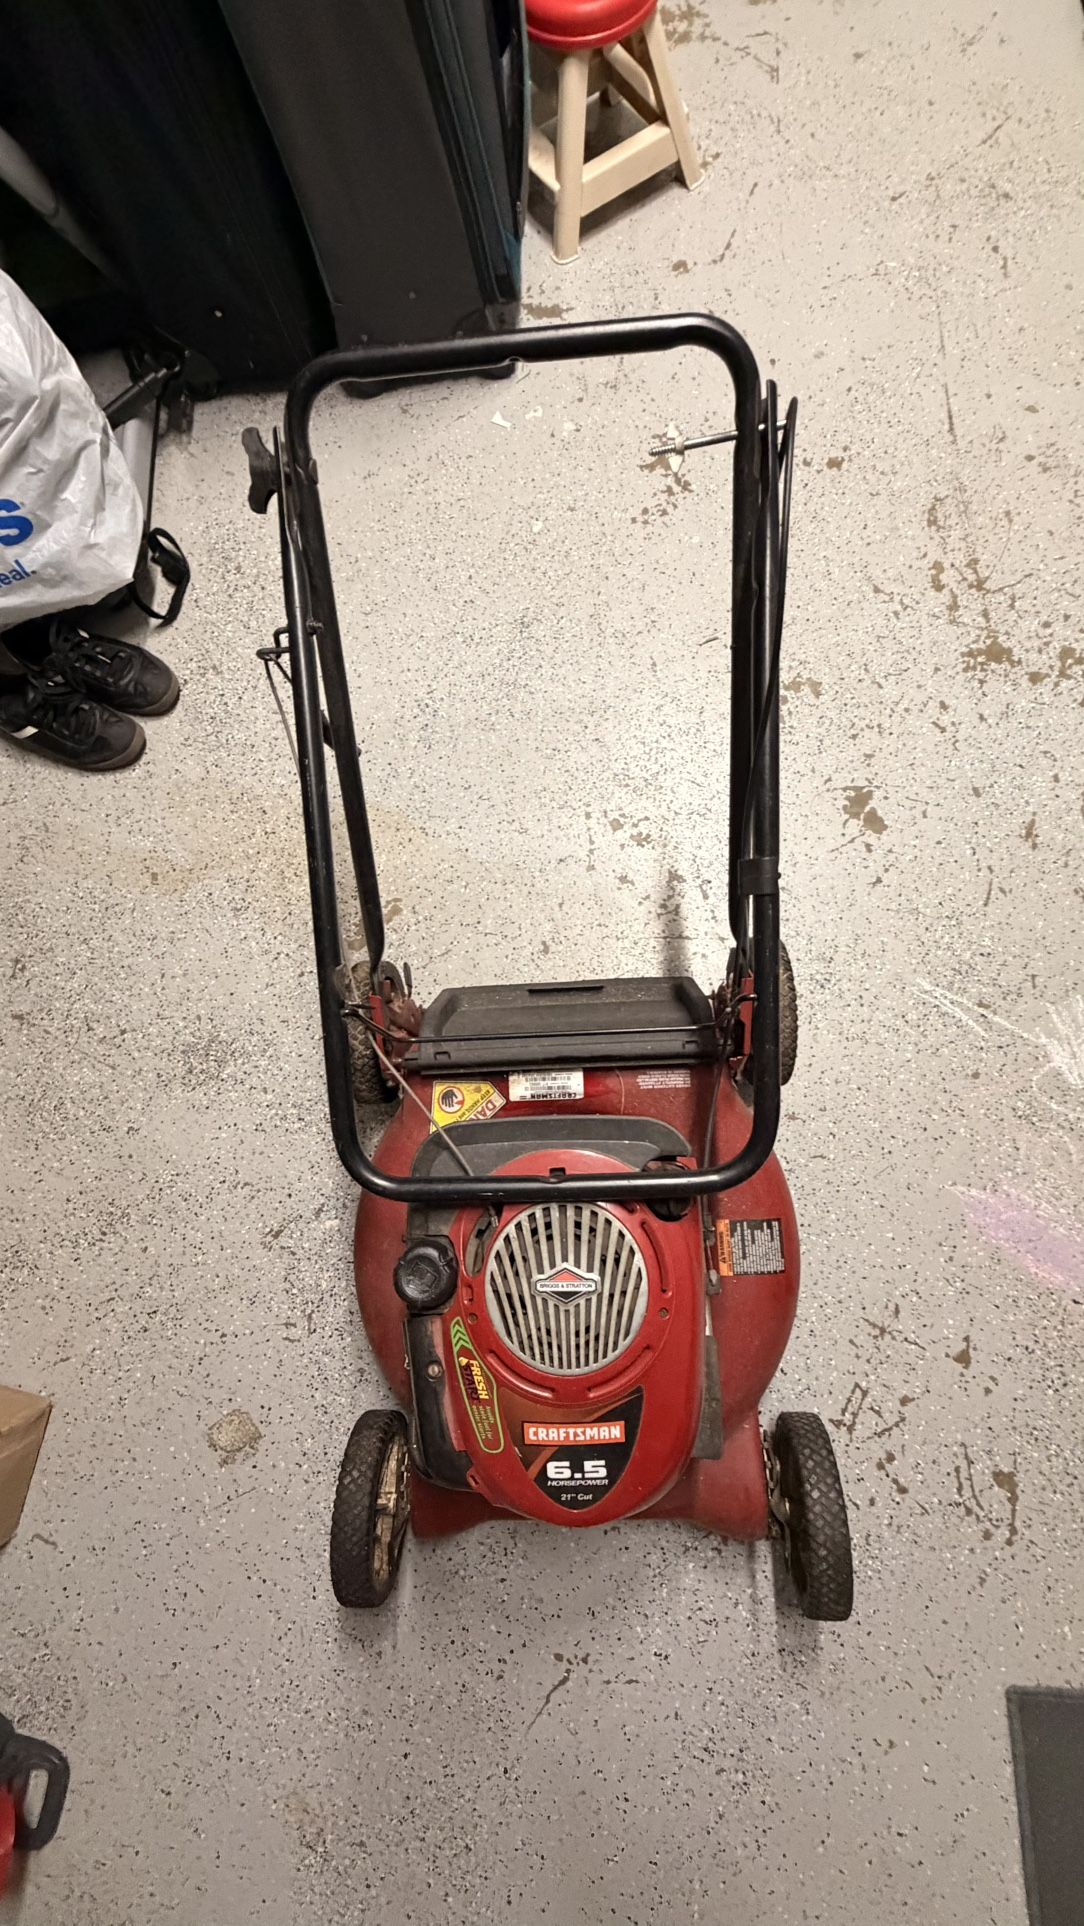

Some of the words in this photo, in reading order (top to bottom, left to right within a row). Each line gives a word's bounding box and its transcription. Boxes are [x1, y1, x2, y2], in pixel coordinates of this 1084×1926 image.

[462, 1362, 481, 1403] START
[469, 1359, 490, 1400] FRESH
[528, 1425, 621, 1441] CRAFTSMAN
[546, 1460, 607, 1479] 6.5
[547, 1479, 609, 1487] HORSEPOWER
[560, 1493, 577, 1501] 21"
